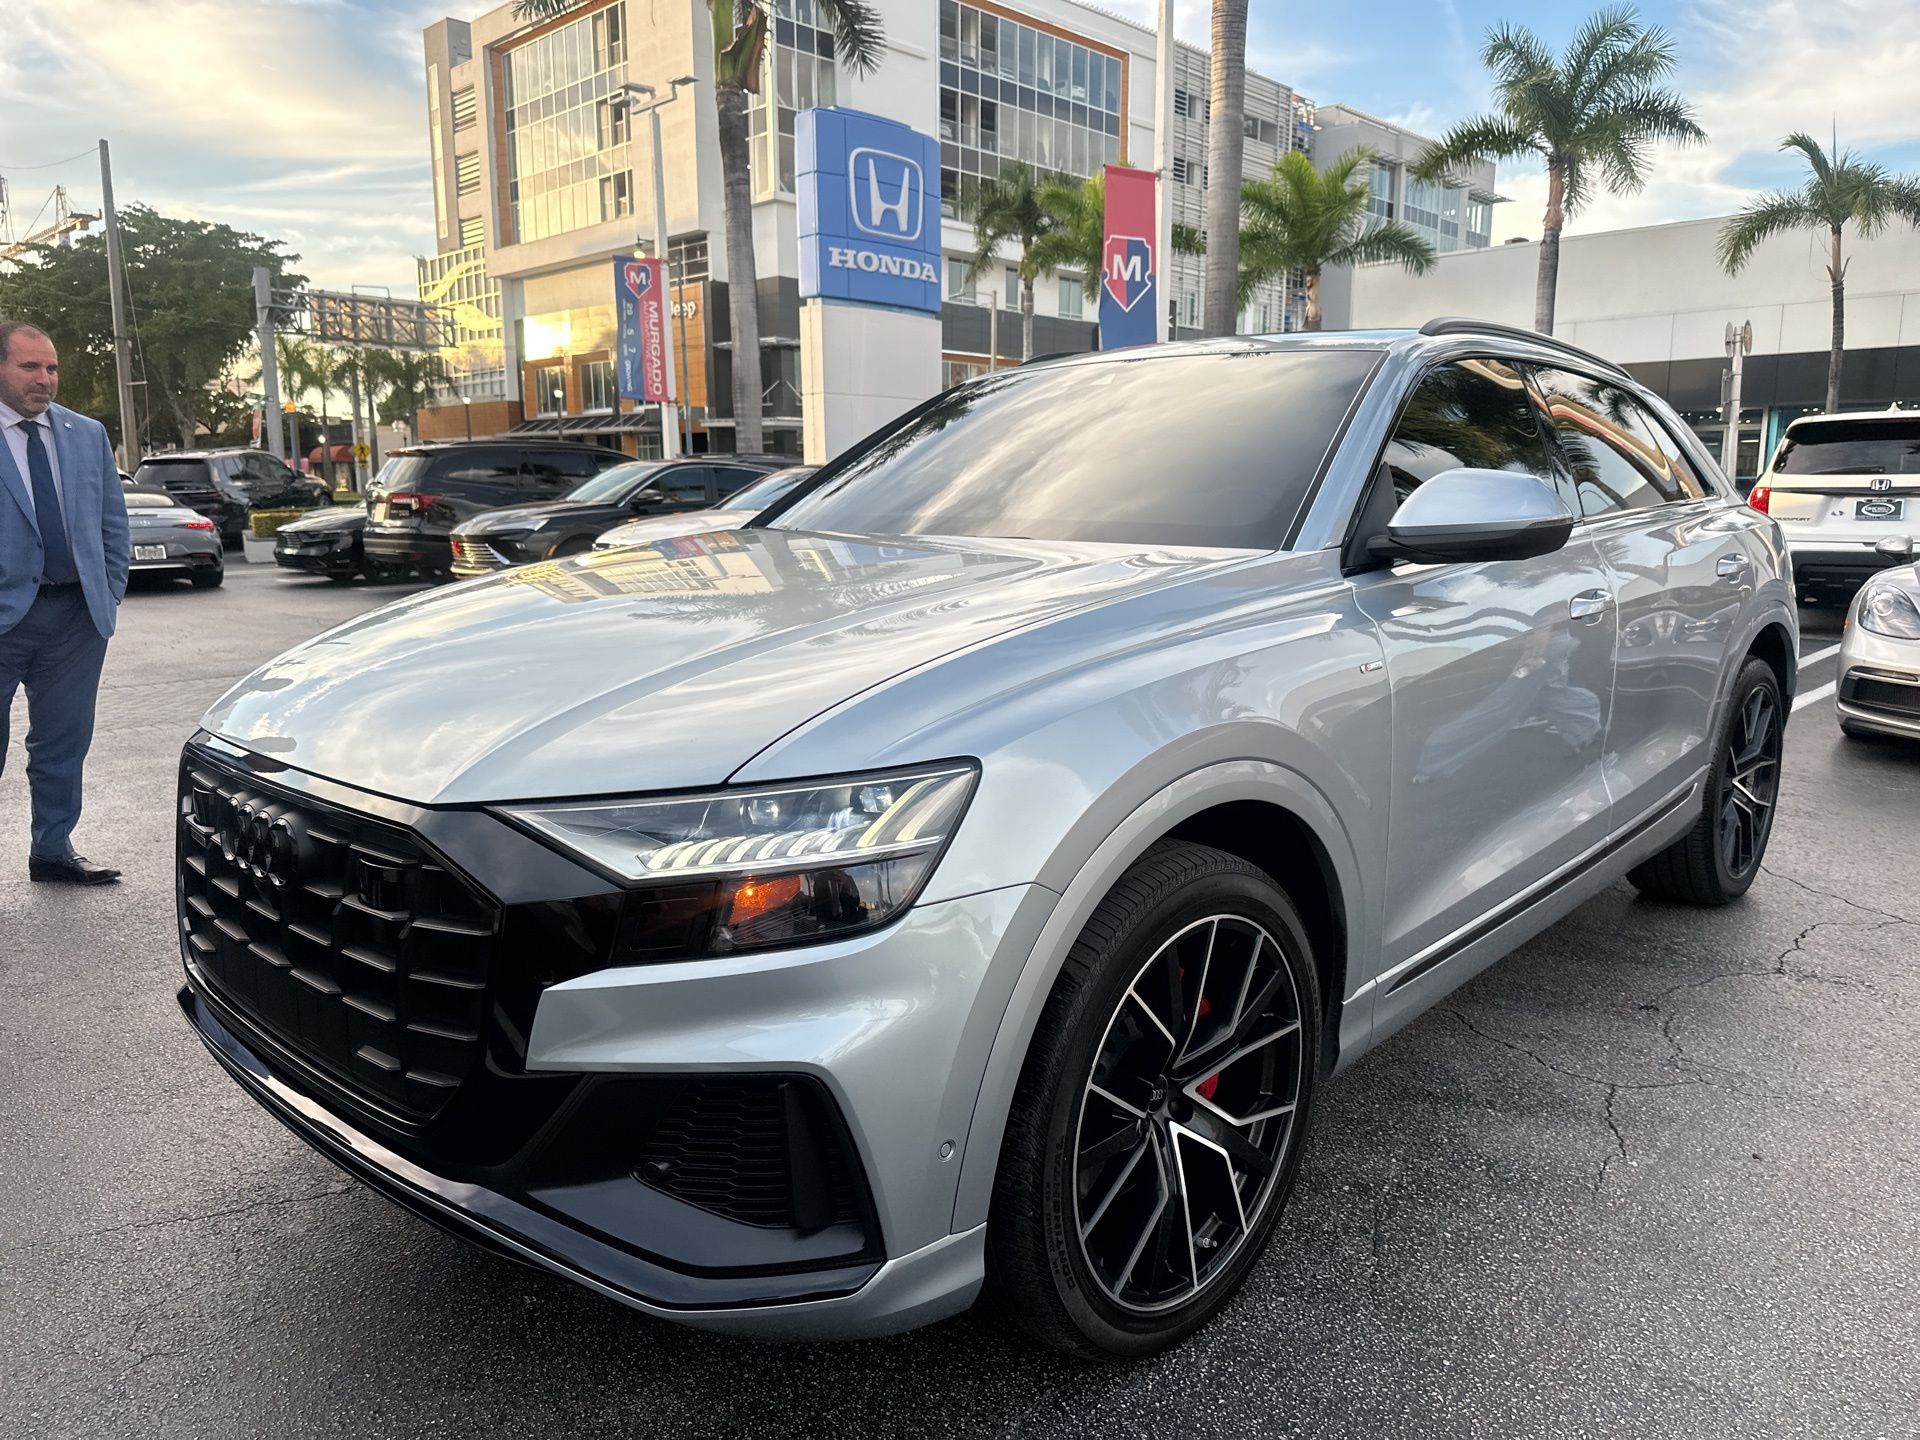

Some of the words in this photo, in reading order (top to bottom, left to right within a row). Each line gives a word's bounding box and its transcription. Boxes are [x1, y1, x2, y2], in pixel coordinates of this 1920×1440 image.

[629, 271, 646, 285] M
[828, 247, 938, 283] HONDA
[1112, 254, 1141, 281] M
[649, 301, 662, 395] MURGADO
